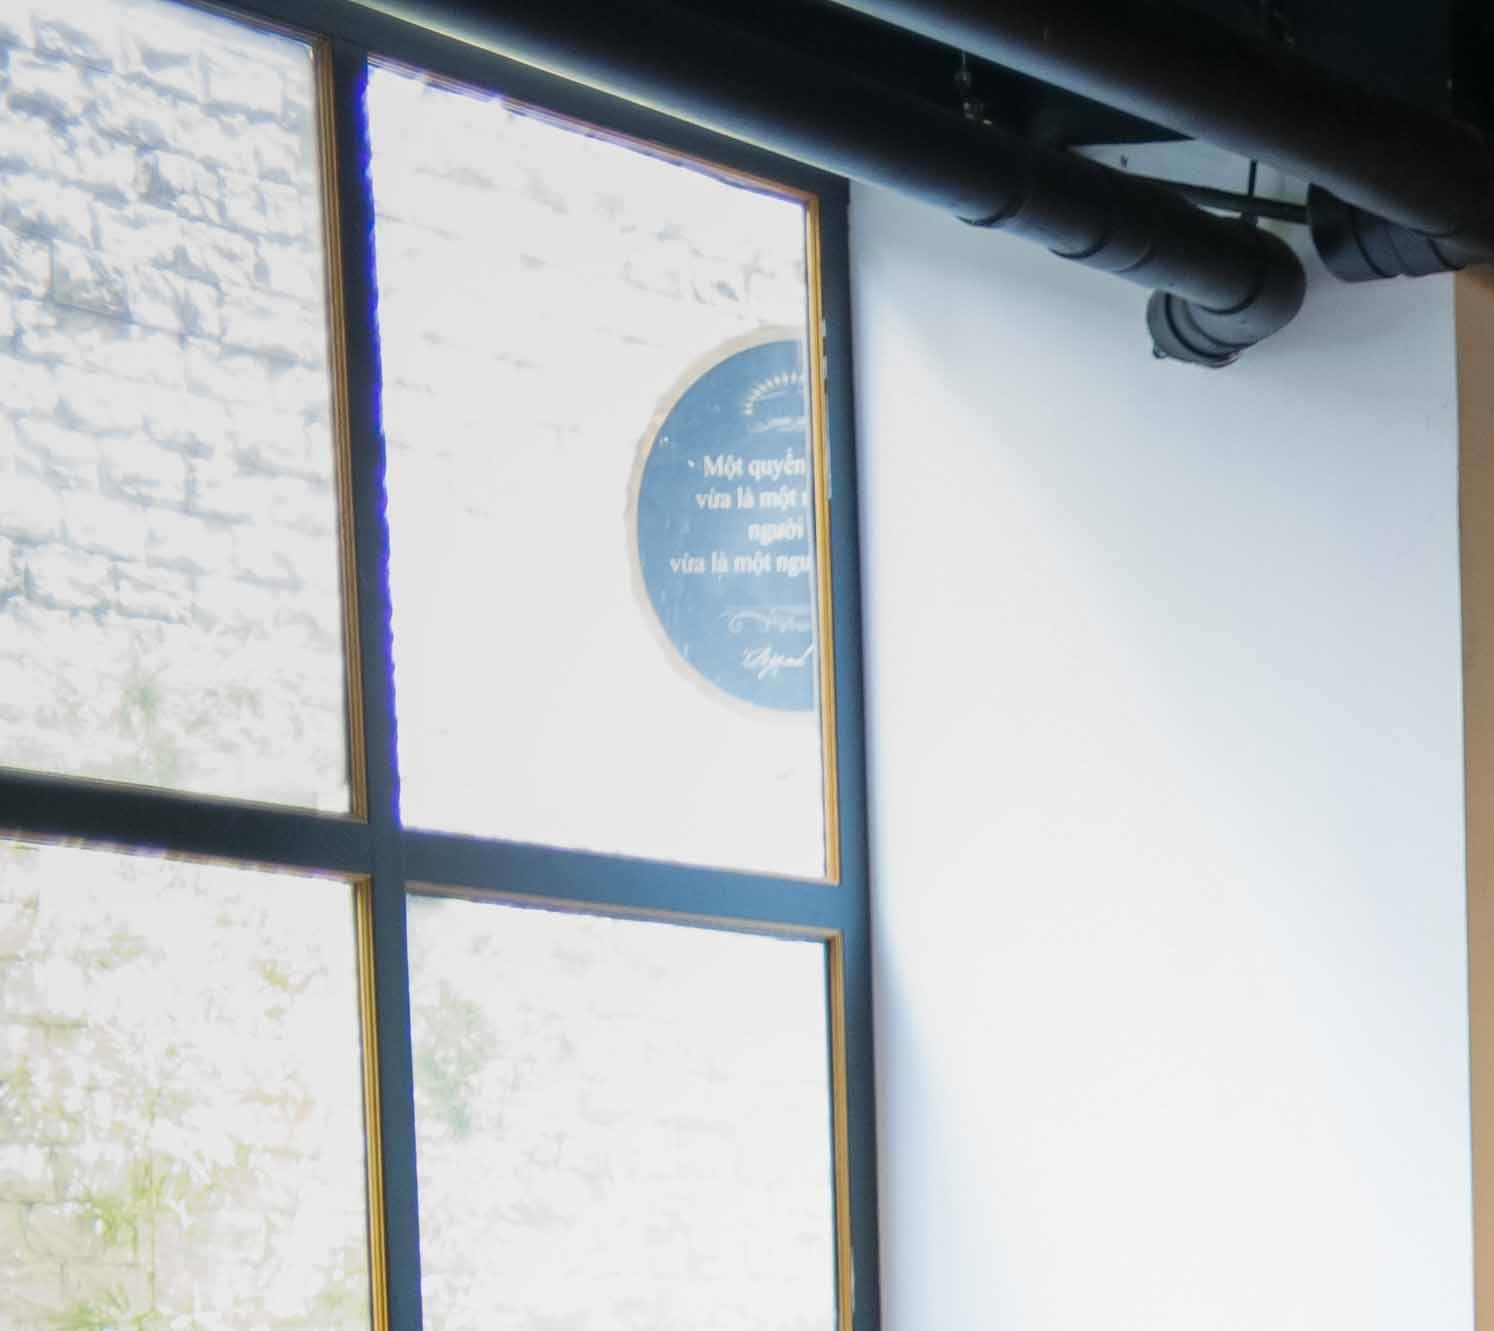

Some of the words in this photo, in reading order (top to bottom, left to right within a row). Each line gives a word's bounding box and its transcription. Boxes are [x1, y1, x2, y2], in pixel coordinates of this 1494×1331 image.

[704, 455, 743, 480] Một
[736, 485, 754, 510] là
[759, 485, 797, 512] một
[733, 550, 771, 577] một
